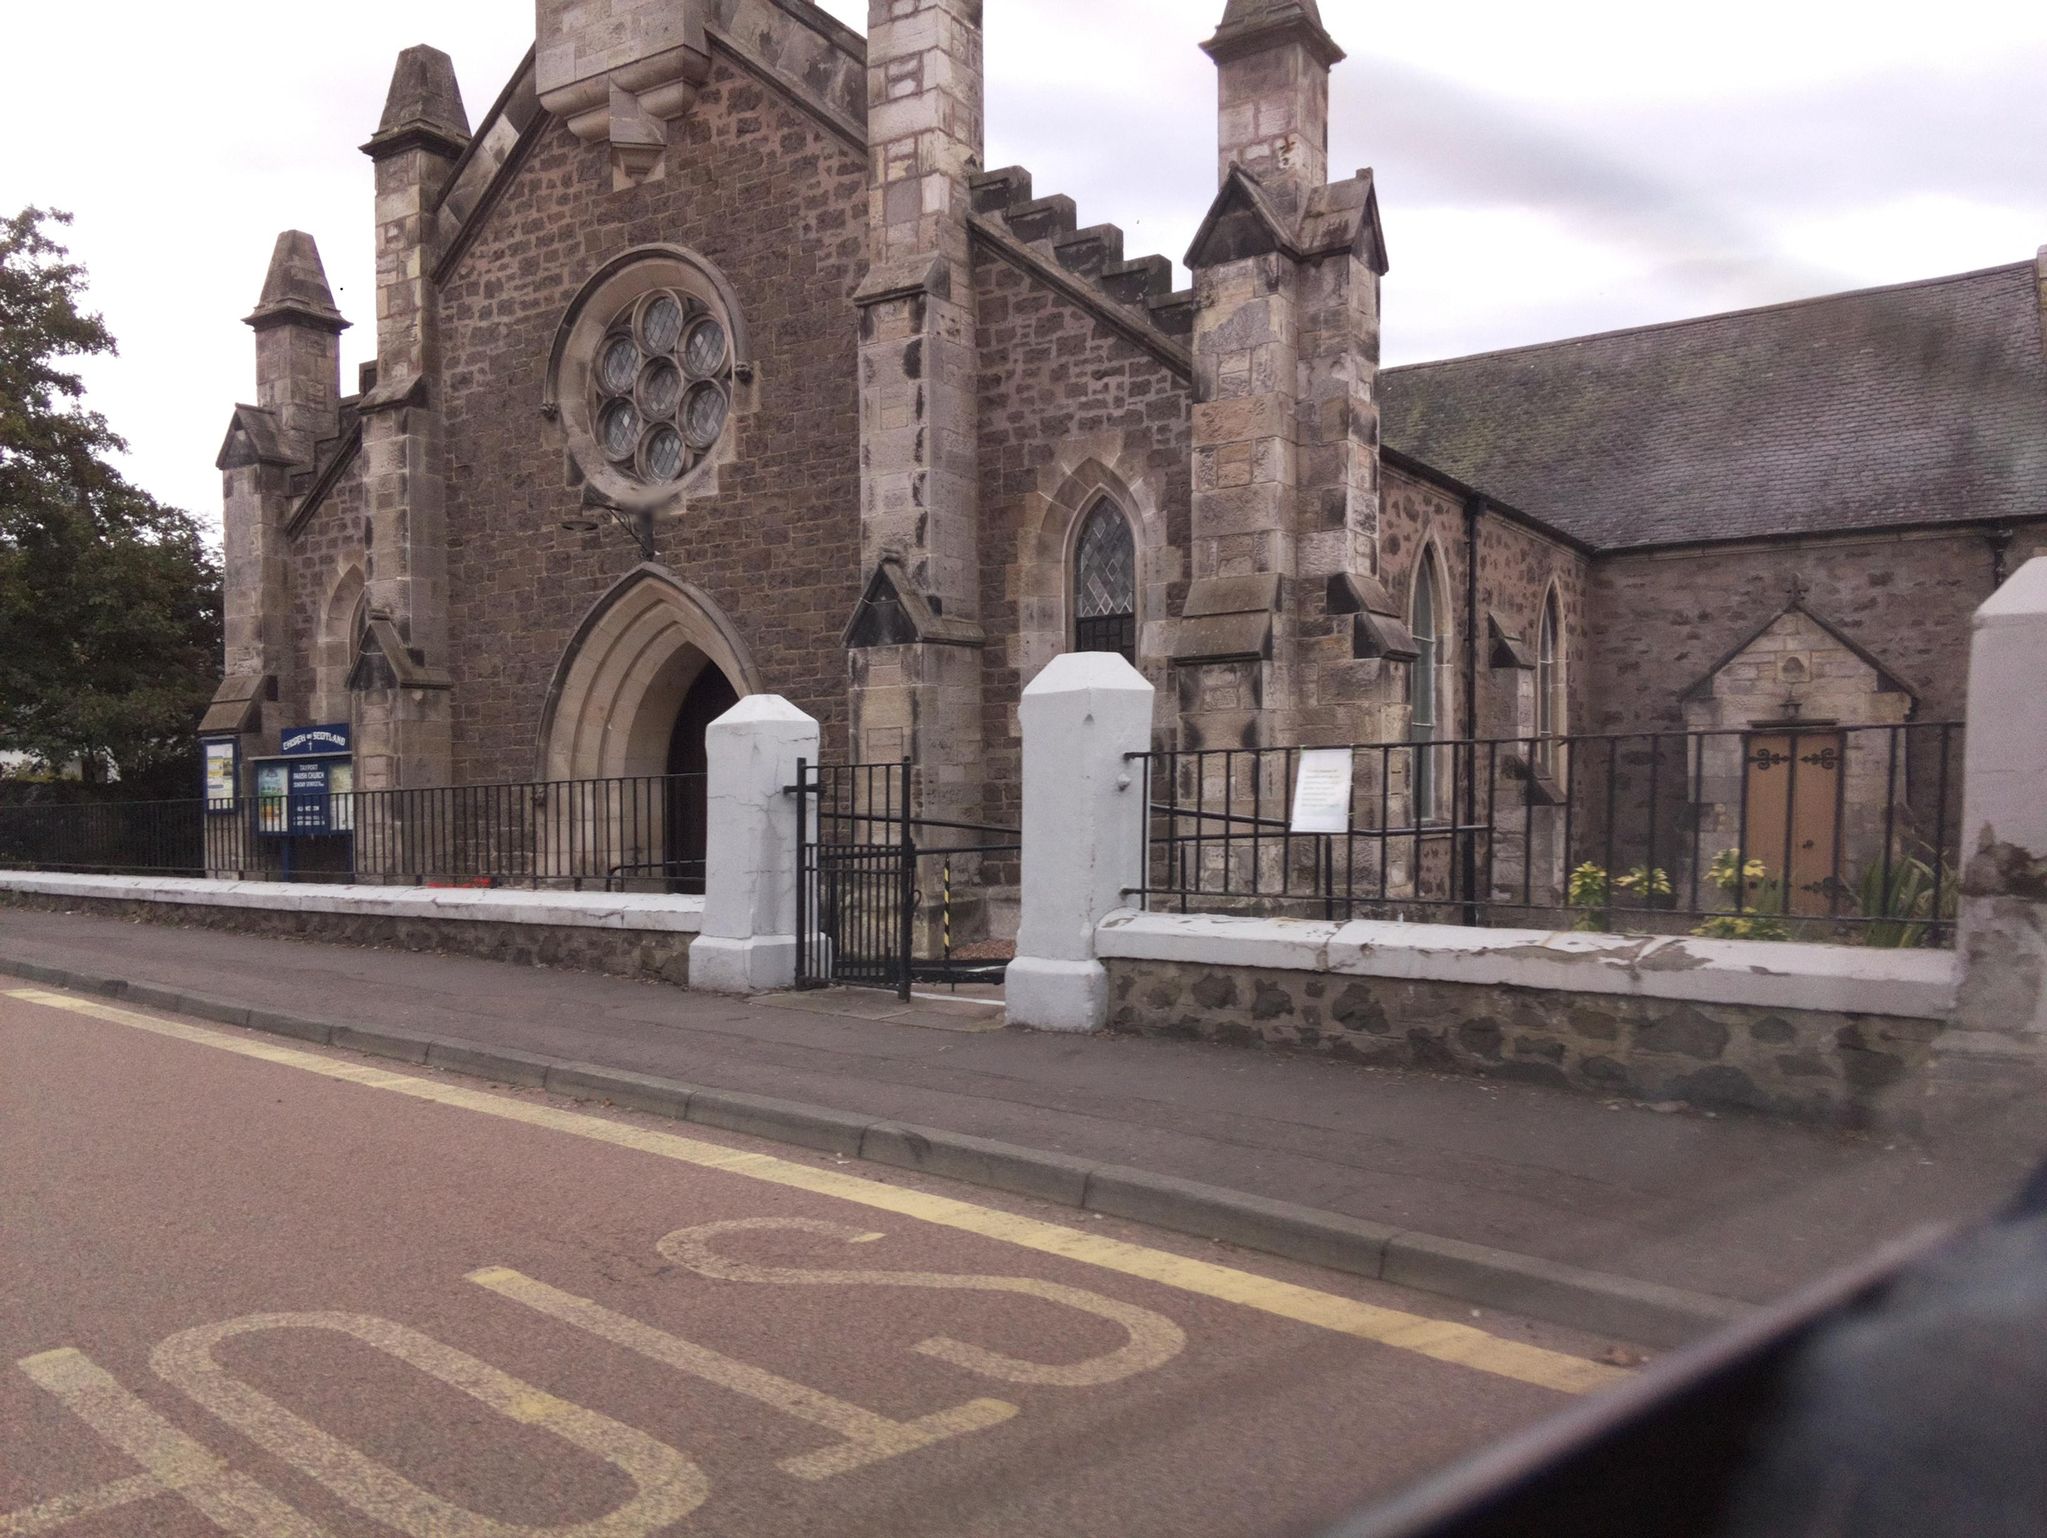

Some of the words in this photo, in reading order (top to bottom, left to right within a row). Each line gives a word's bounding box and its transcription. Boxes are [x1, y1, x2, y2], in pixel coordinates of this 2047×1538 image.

[283, 734, 306, 750] CHURCH
[313, 731, 346, 746] SCOTLAND
[308, 771, 325, 779] CHURCH
